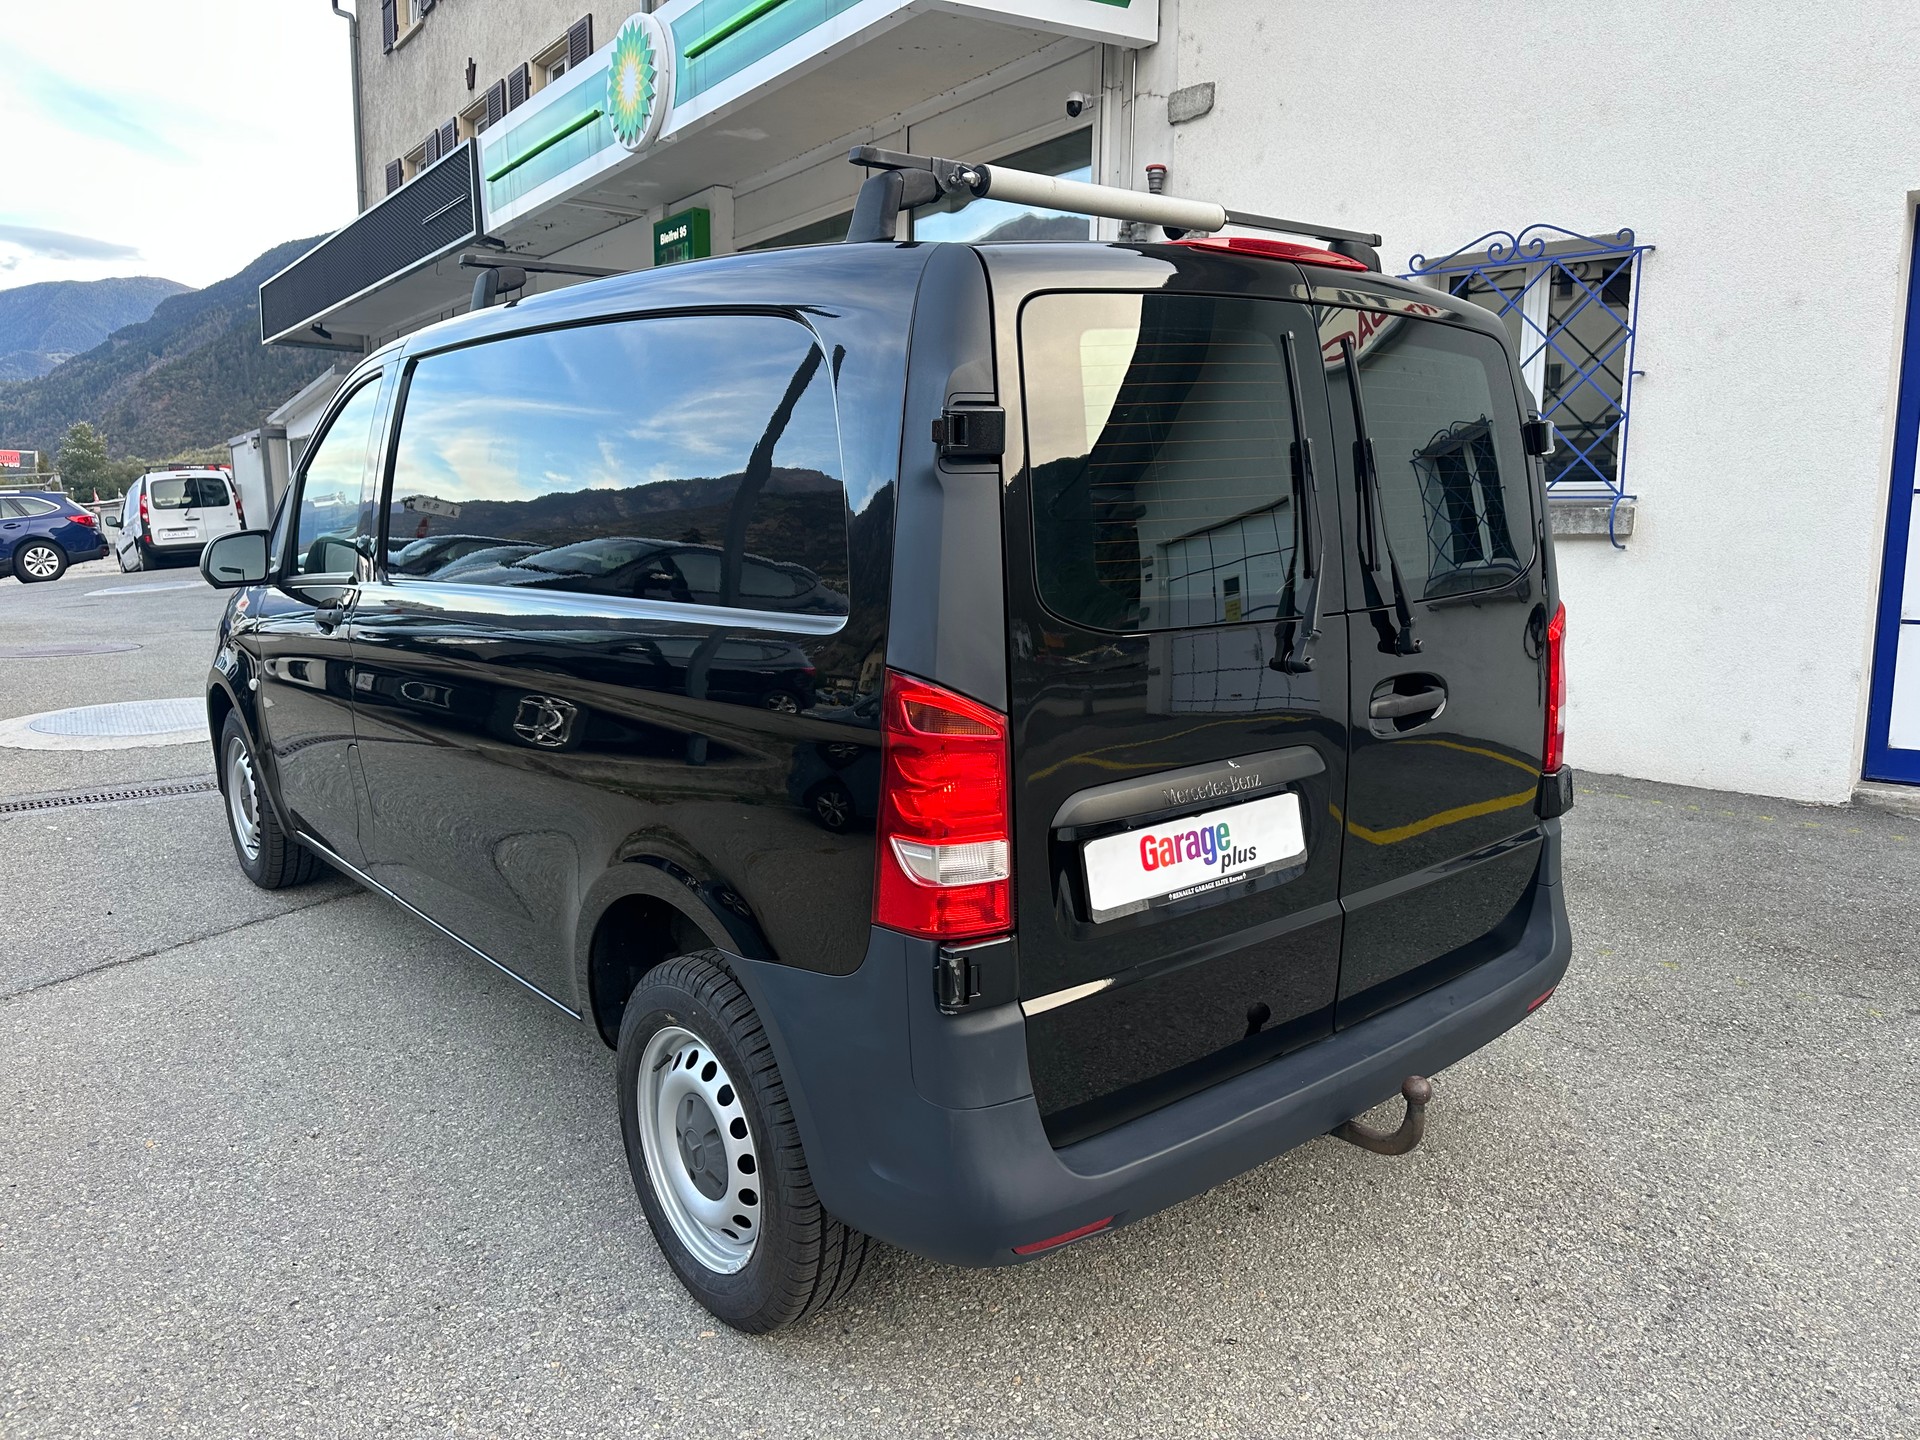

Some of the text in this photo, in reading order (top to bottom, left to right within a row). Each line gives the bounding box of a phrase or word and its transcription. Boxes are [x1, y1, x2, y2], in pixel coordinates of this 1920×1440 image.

[680, 225, 687, 238] 95
[1163, 774, 1262, 806] Mercedes-Benz
[1140, 822, 1231, 872] Garage
[1221, 846, 1257, 874] plus
[1172, 887, 1195, 900] RENAULT
[1194, 882, 1215, 893] GARAGE
[1215, 877, 1229, 888] ELITE
